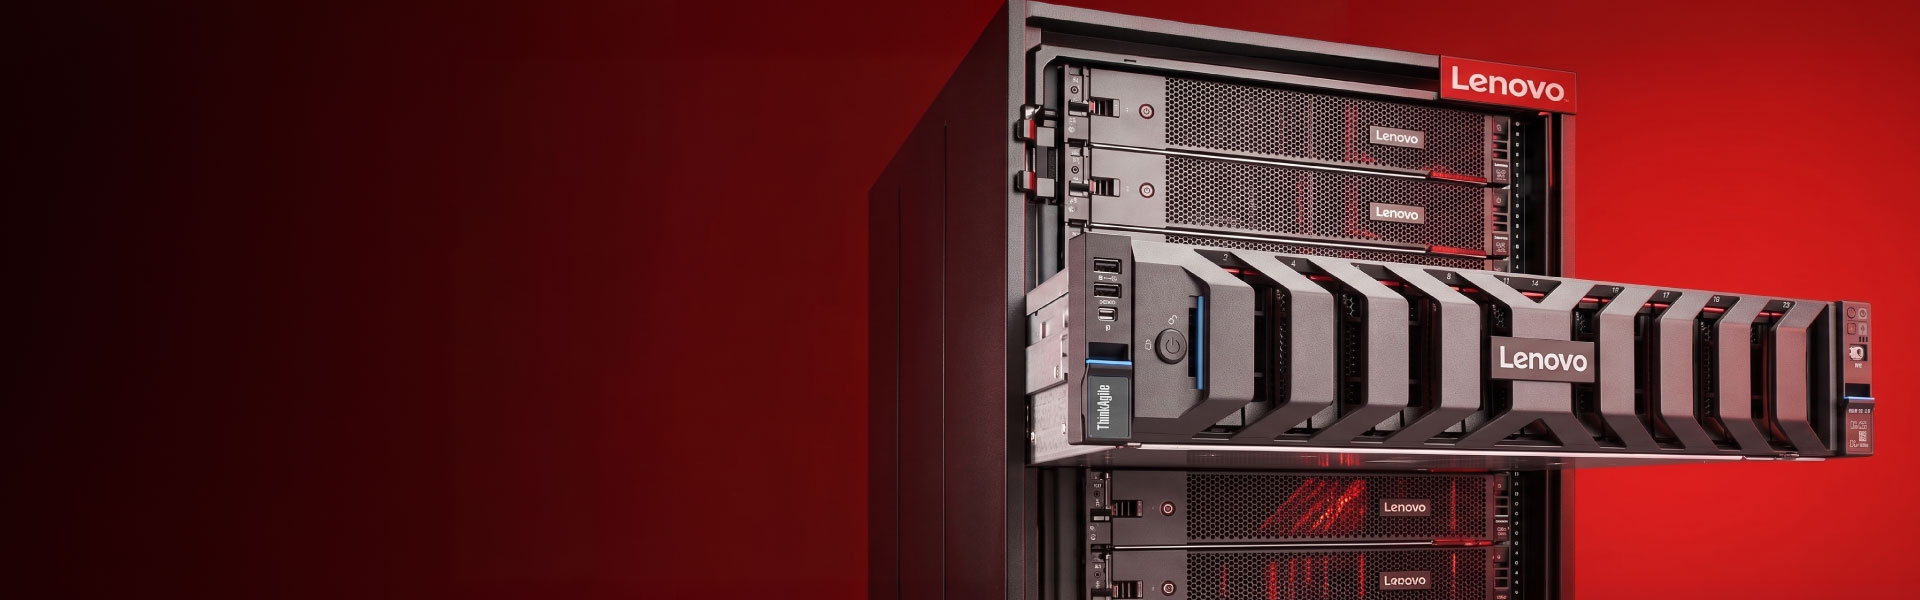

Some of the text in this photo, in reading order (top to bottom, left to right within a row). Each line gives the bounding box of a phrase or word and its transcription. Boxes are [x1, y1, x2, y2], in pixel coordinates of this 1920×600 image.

[1452, 66, 1564, 101] Lenovo
[1376, 130, 1418, 144] Lenovo
[1376, 206, 1419, 220] Lenovo
[1500, 345, 1588, 372] Lenovo
[1096, 384, 1113, 431] ThinkAgile
[1384, 502, 1426, 512] Lenovo
